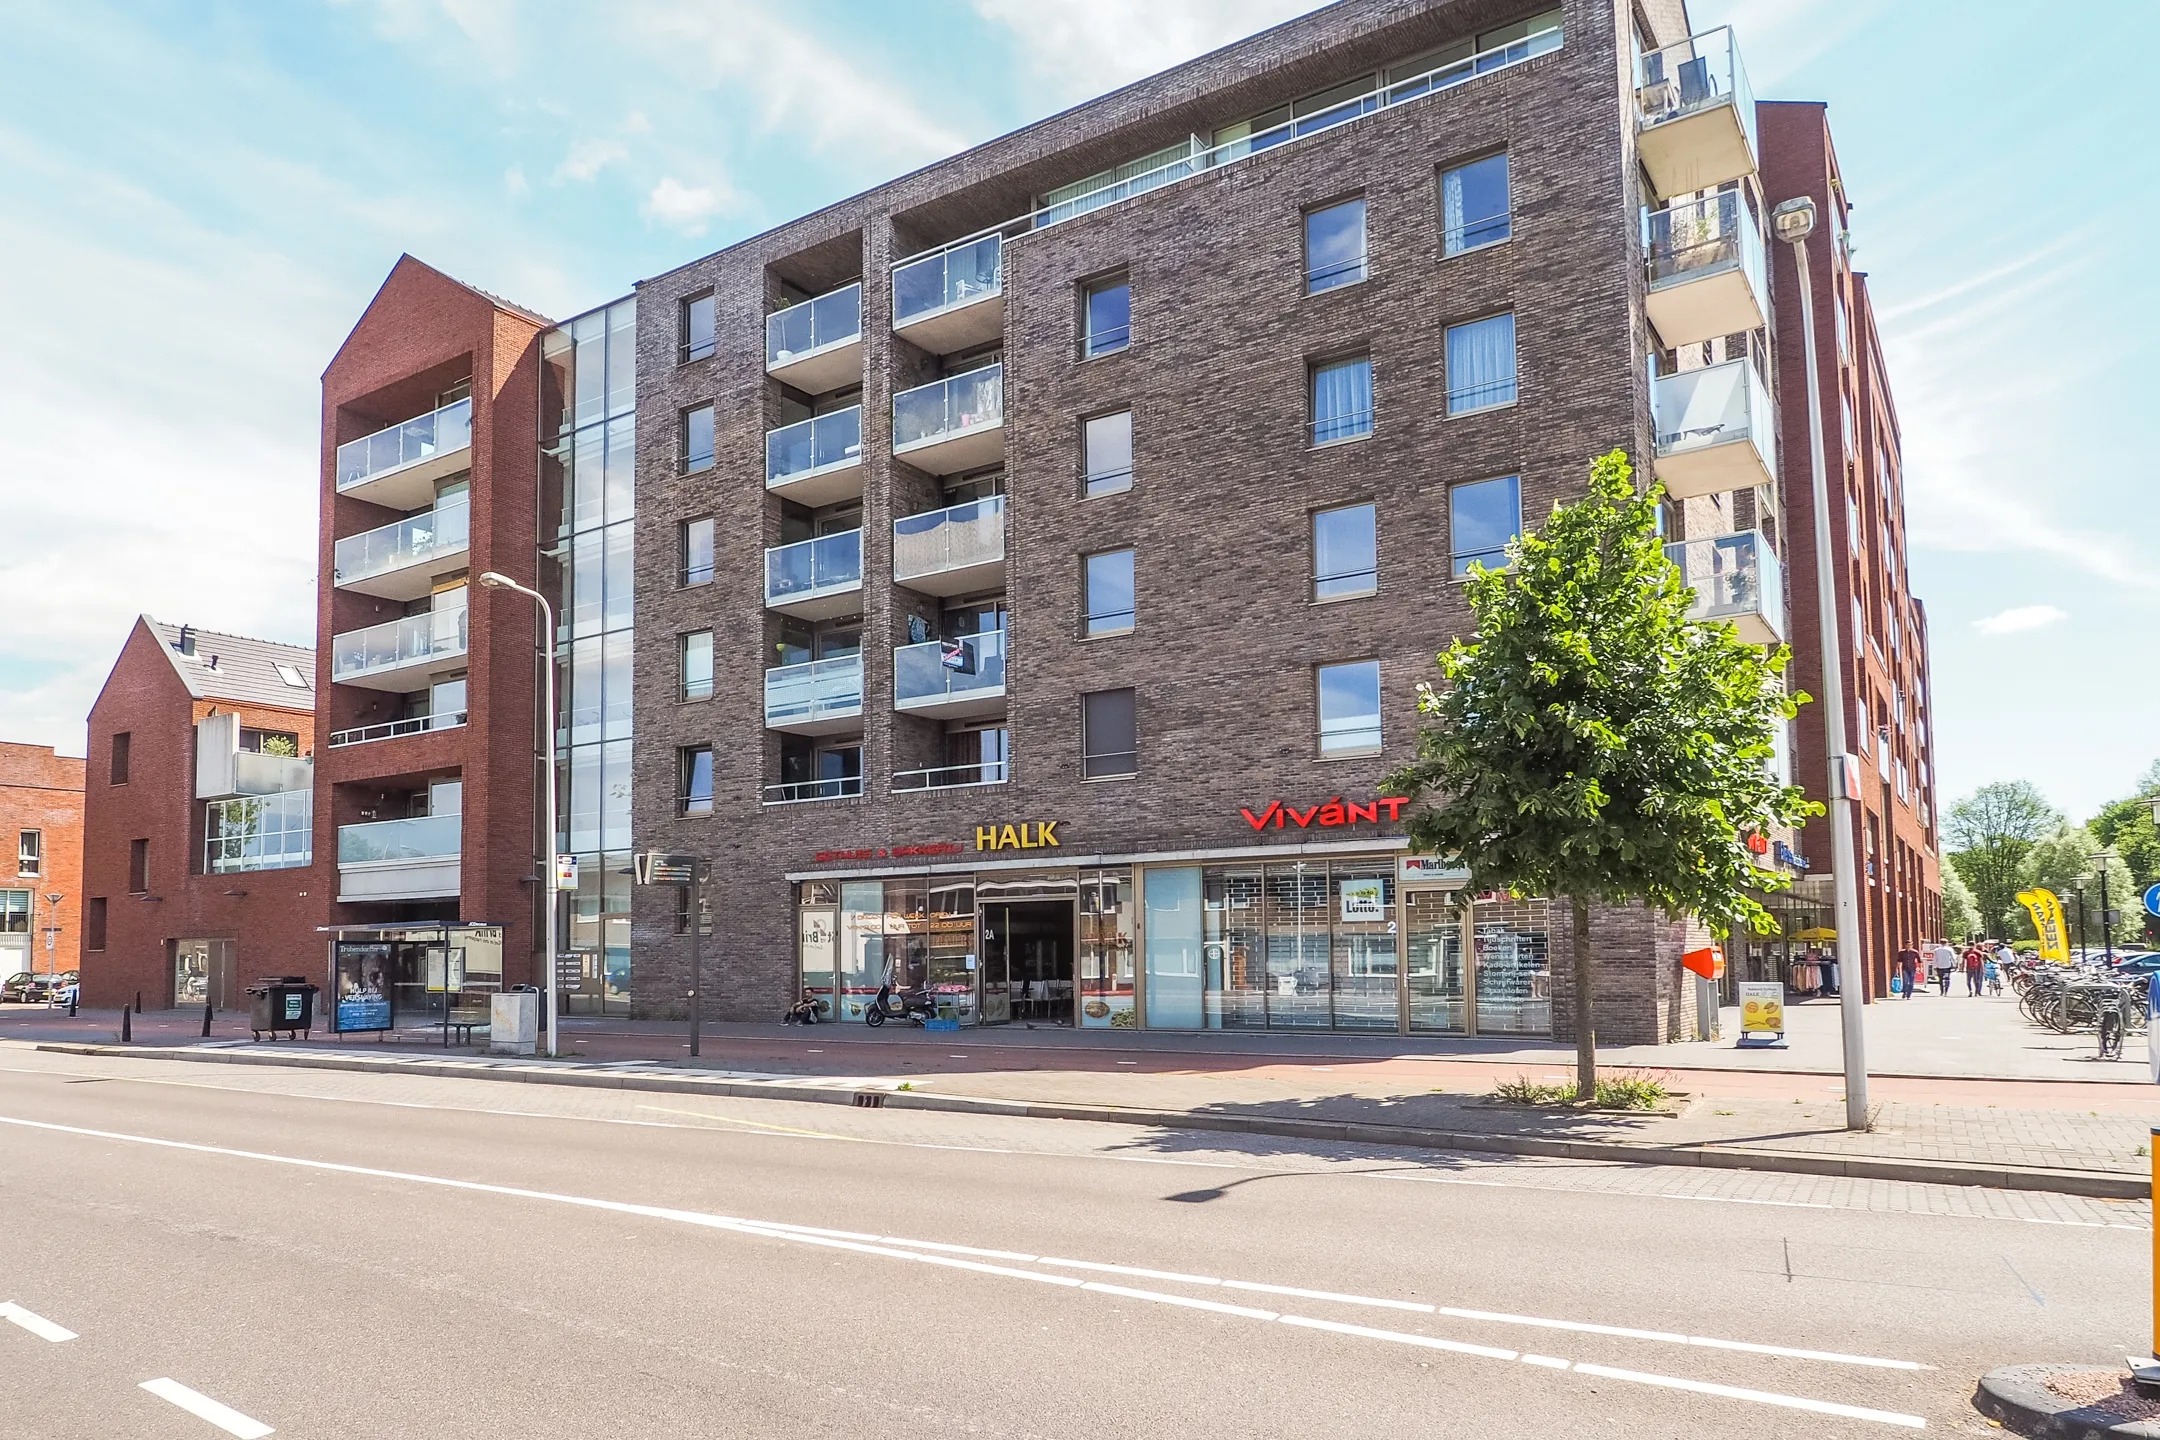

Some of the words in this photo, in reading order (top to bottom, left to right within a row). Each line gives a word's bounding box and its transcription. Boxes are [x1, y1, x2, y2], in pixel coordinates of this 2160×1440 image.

[976, 820, 1060, 851] HALK
[1420, 858, 1466, 870] Marlb
[1387, 921, 1397, 934] 2
[985, 929, 995, 940] 2A
